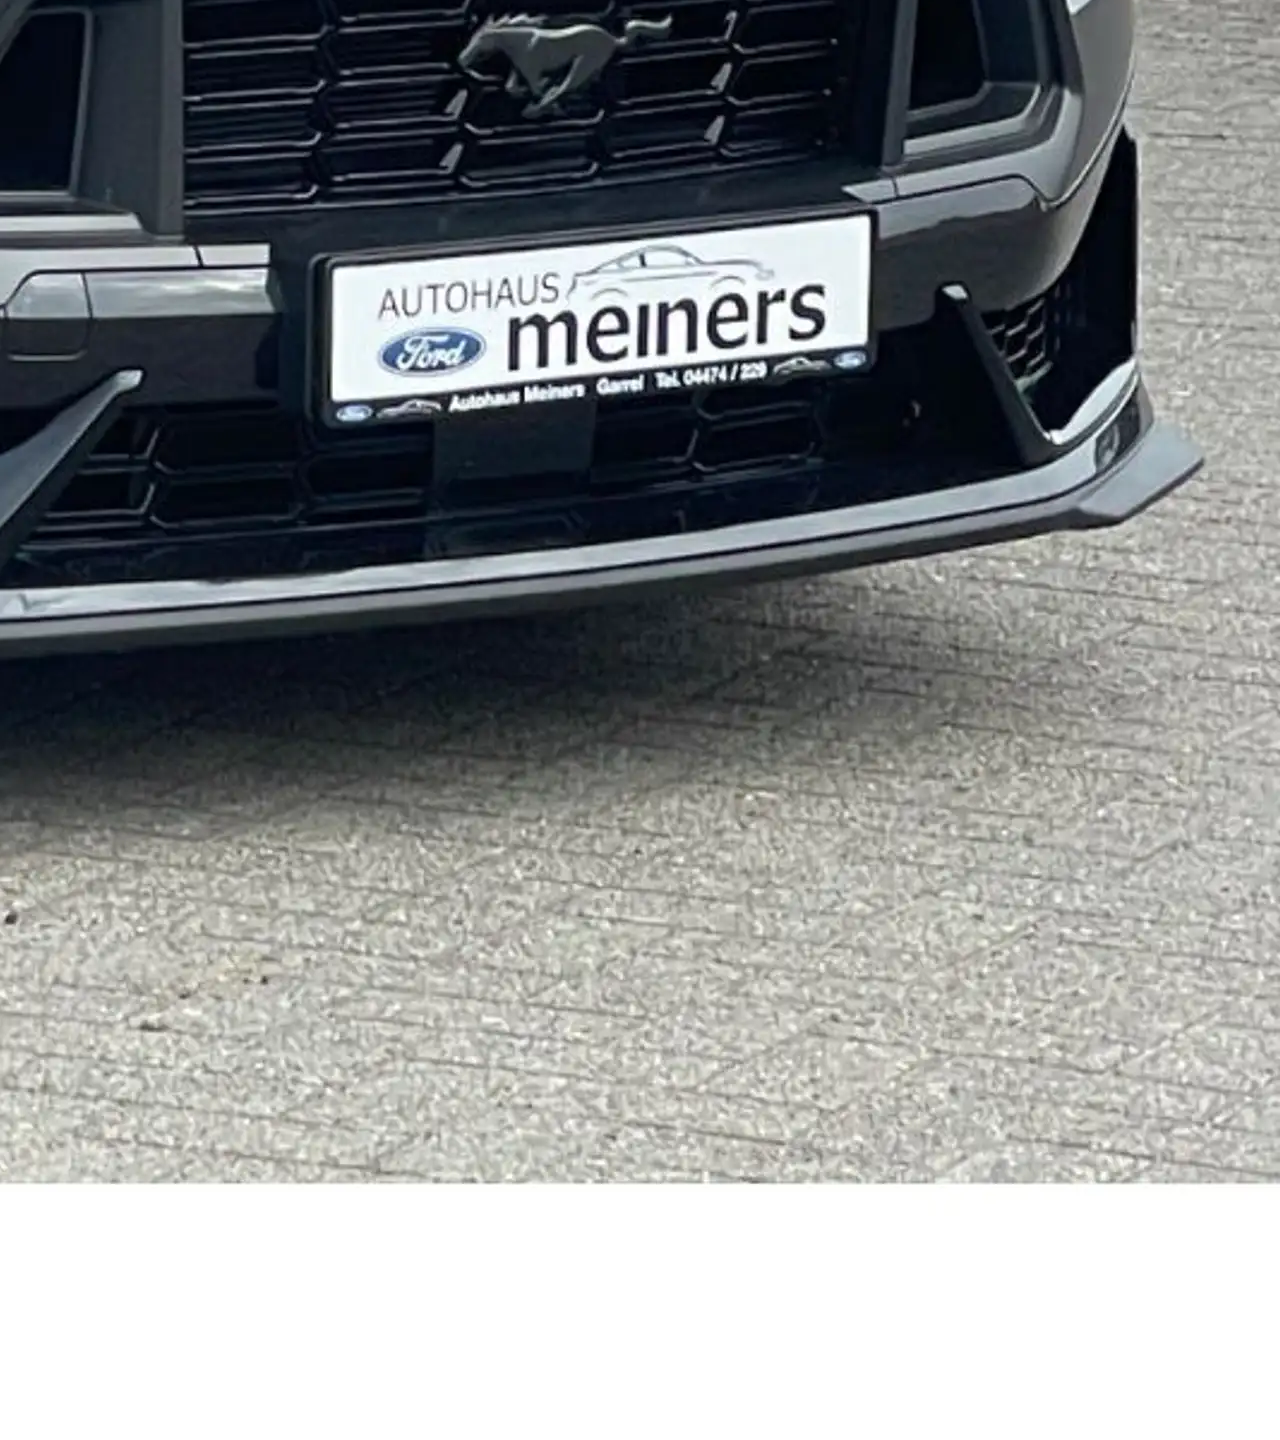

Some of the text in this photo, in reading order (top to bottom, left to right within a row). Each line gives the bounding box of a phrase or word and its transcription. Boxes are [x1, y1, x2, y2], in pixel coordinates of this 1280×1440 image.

[377, 271, 561, 320] AUTOHAUS
[507, 282, 828, 372] meiners
[396, 333, 467, 371] Ford
[448, 389, 521, 413] Autohaus
[524, 382, 586, 403] Meiners
